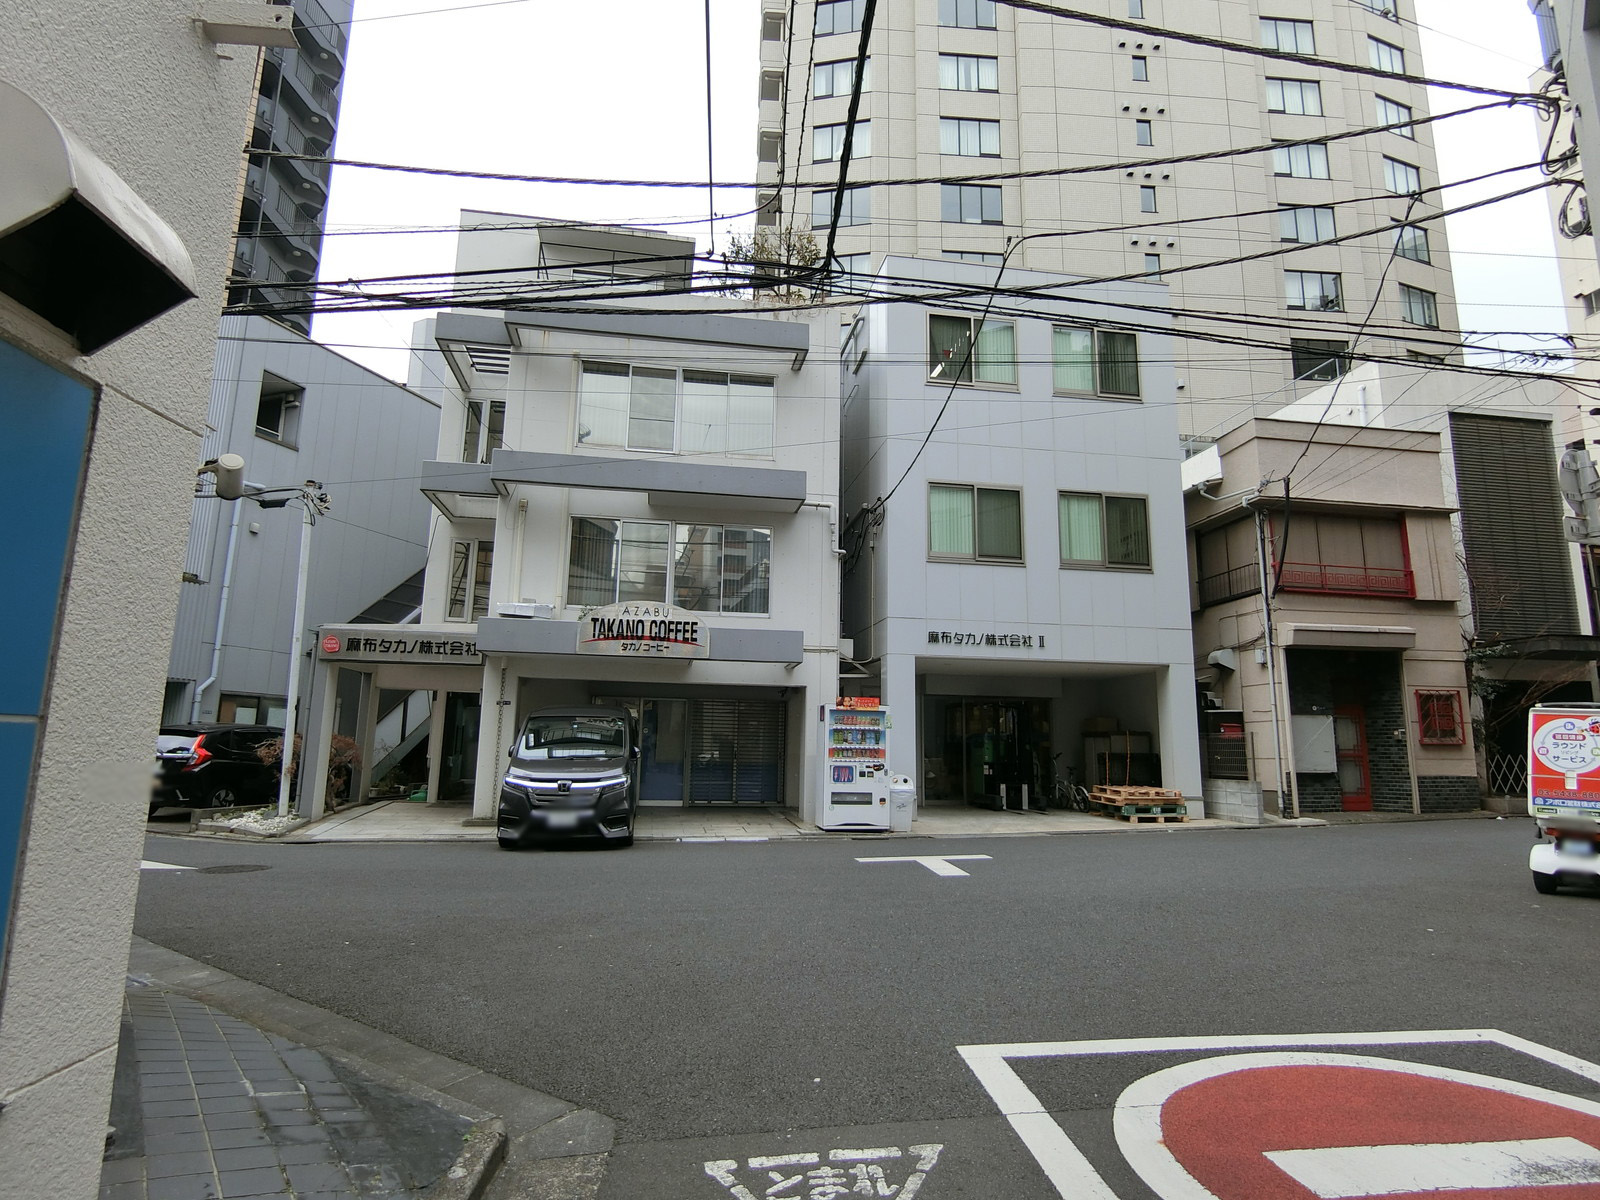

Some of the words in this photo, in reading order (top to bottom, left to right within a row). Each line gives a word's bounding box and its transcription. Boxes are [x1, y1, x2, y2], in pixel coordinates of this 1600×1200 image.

[622, 606, 670, 618] AZABU
[591, 617, 645, 640] TAKANO
[649, 619, 699, 642] COFFEE
[927, 631, 1033, 648] 麻布タカノ株式会社
[345, 637, 479, 656] 麻布タカノ株式会社
[621, 642, 670, 652] タカノコーヒー
[1552, 741, 1587, 750] ラウンド
[1552, 755, 1587, 764] サービス
